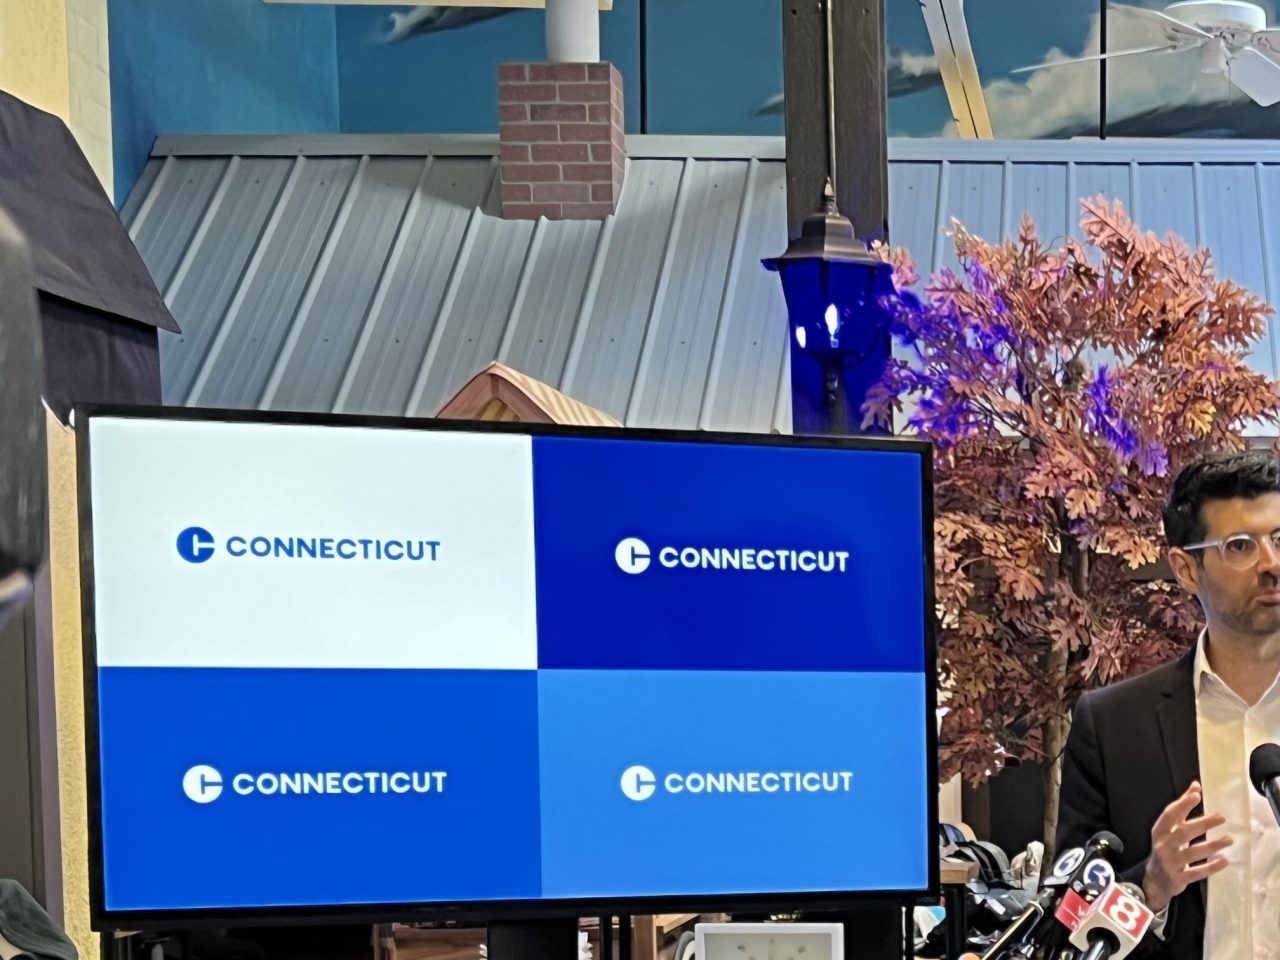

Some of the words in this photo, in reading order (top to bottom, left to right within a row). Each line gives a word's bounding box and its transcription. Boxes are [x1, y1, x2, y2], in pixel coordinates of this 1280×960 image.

[226, 535, 441, 561] CONNECTICUT
[658, 546, 850, 573] CONNECTICUT
[232, 771, 448, 796] CONNECTICUT
[664, 771, 854, 794] CONNECTICUT
[1109, 895, 1141, 931] 8
